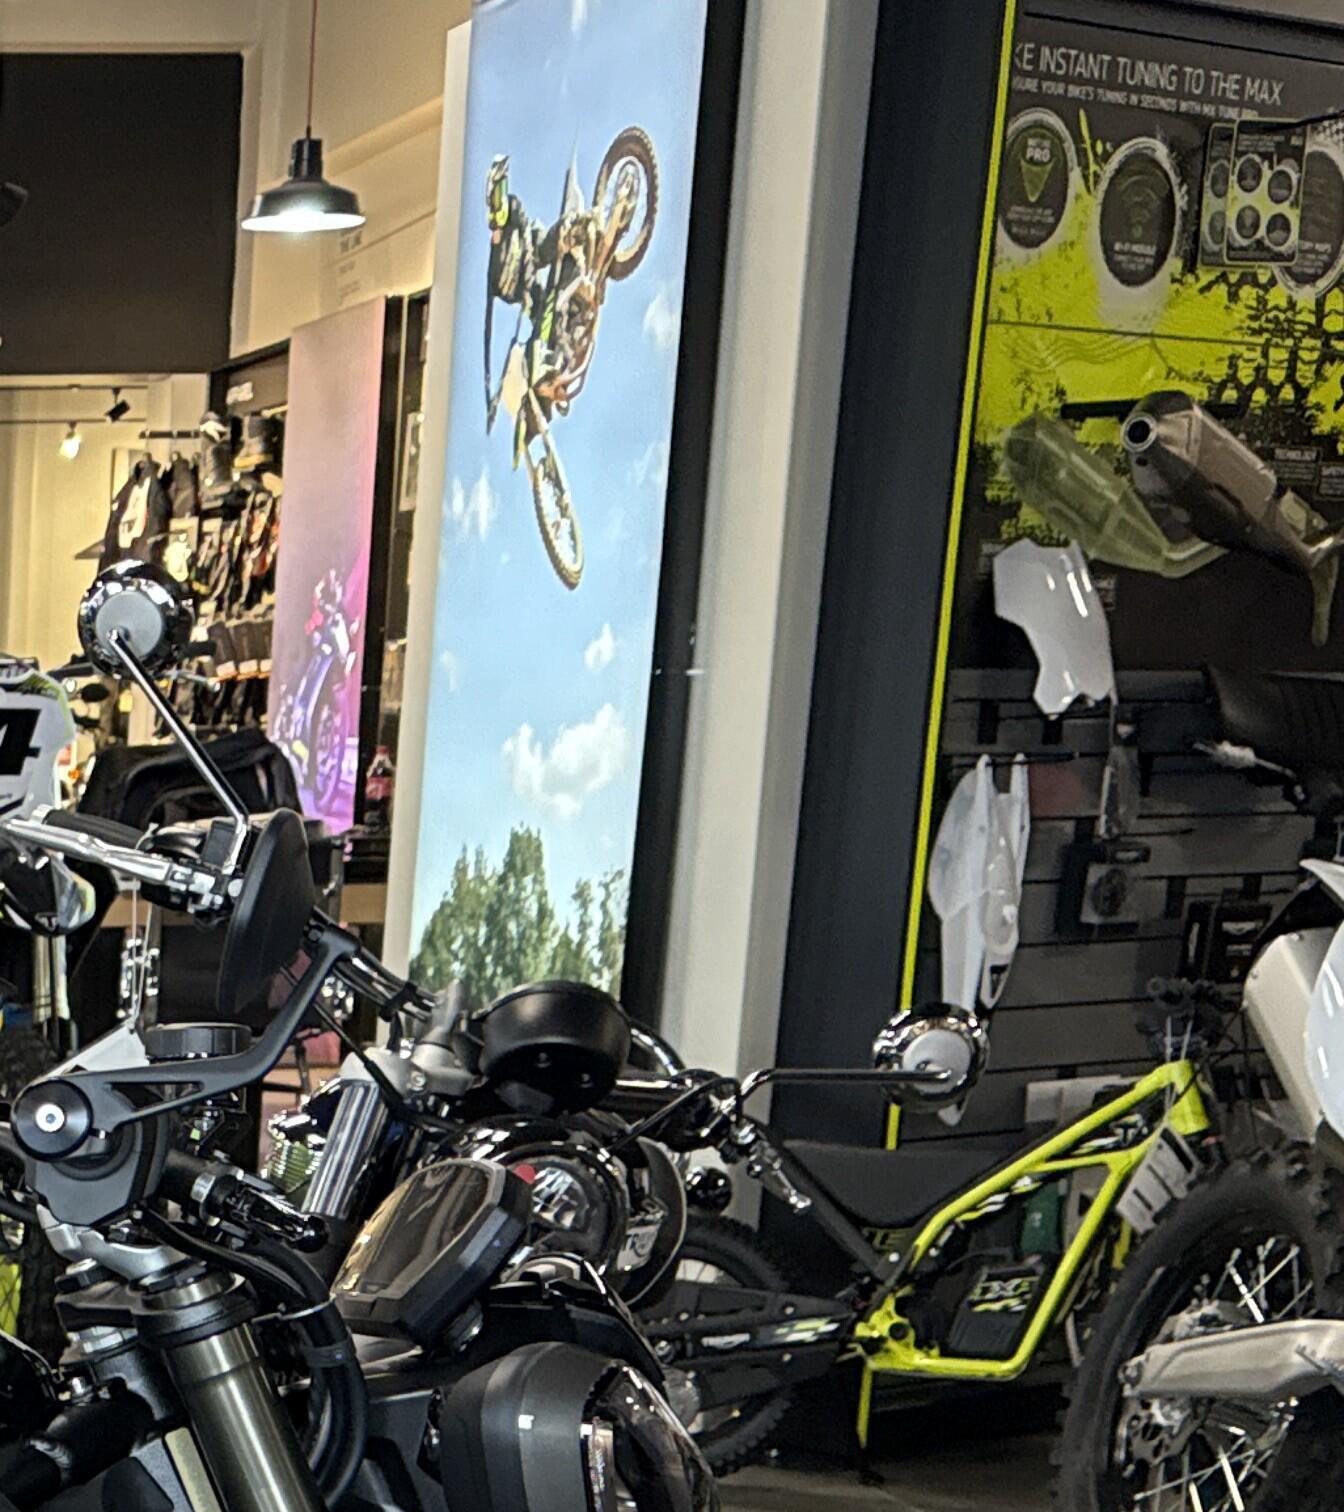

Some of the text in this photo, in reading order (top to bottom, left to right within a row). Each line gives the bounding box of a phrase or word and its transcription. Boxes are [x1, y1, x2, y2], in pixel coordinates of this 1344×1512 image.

[1039, 46, 1112, 81] INSTANT
[1116, 57, 1178, 92] TUNING
[1183, 67, 1205, 95] TO
[1210, 70, 1242, 101] THE
[1244, 77, 1285, 106] MAX
[1026, 148, 1051, 163] PRO
